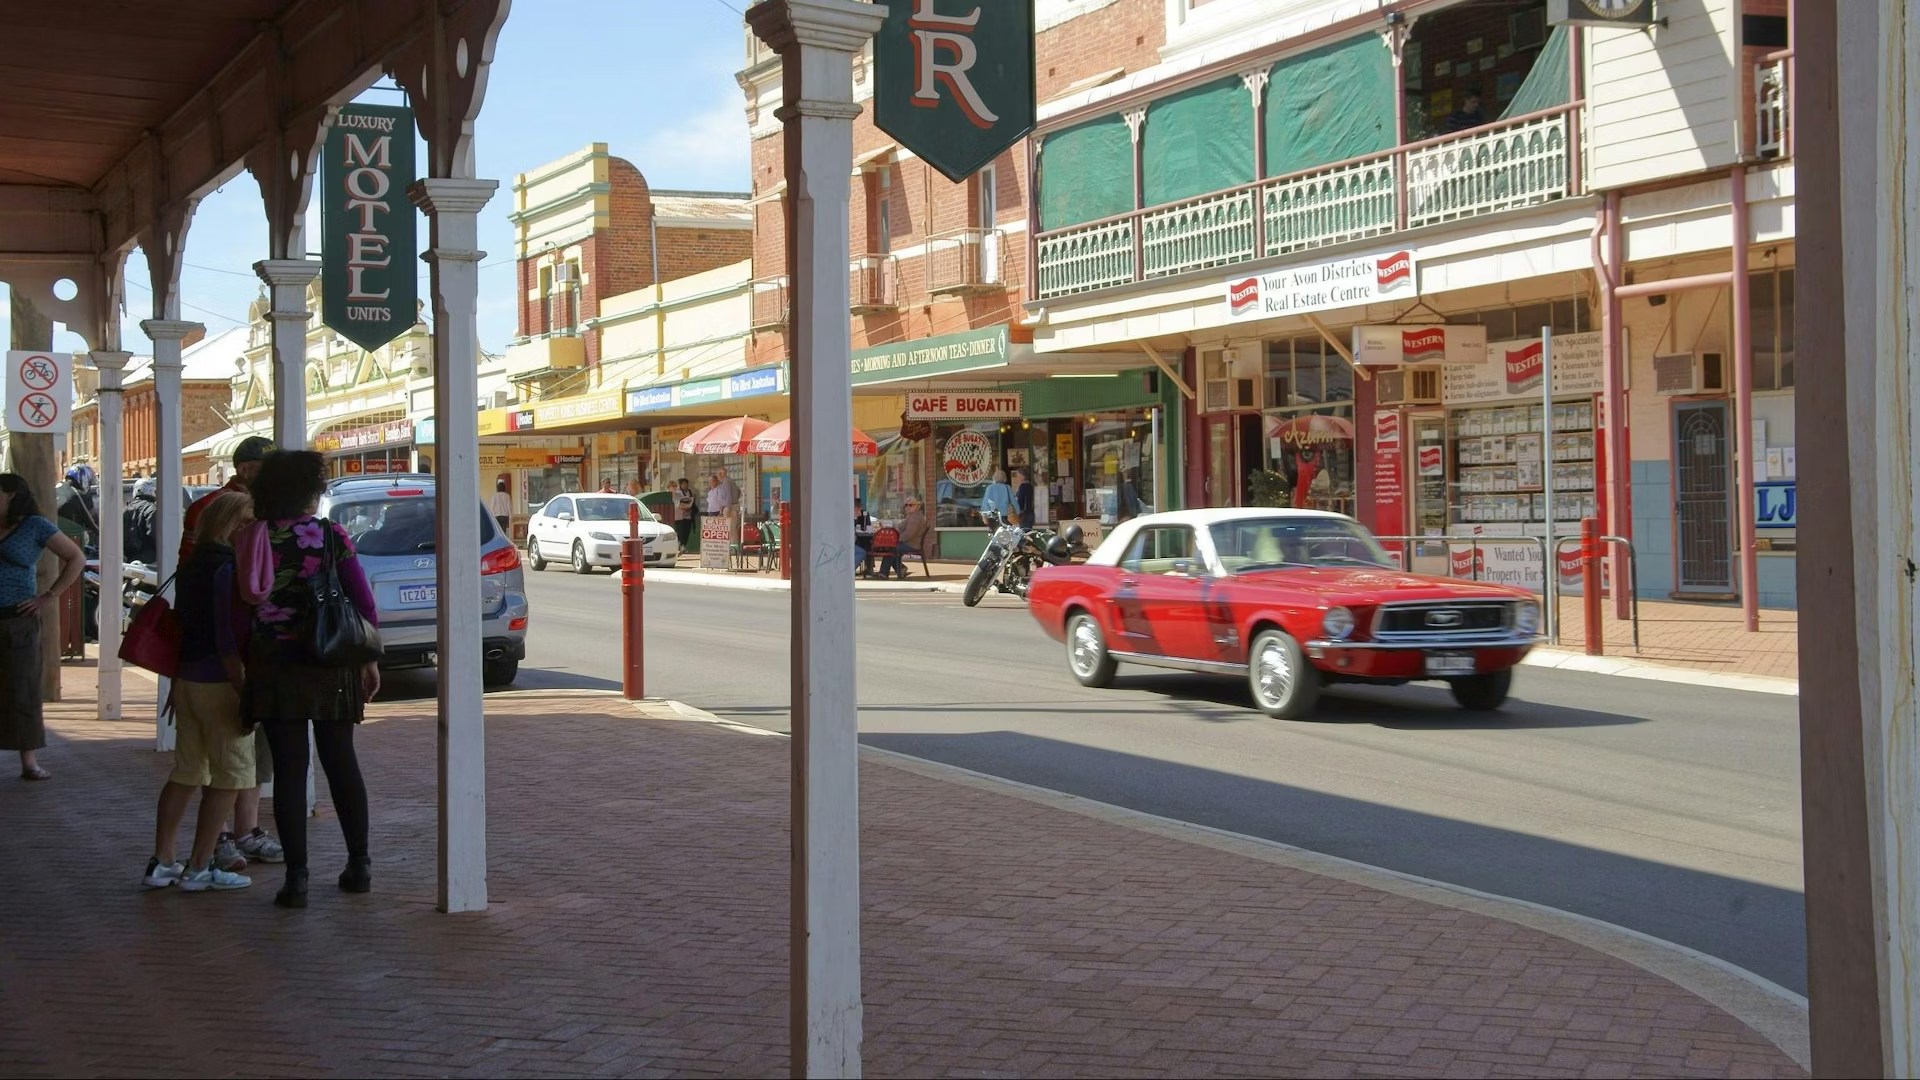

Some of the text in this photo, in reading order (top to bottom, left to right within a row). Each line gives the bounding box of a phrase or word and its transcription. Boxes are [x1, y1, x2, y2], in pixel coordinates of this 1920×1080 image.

[338, 113, 397, 133] LUXURY
[343, 132, 393, 303] MOTEL
[1262, 258, 1373, 292] Your Avon Districts
[1378, 259, 1410, 278] WESTERN
[1230, 285, 1258, 302] WESTERN
[1265, 284, 1371, 313] Real Estate Centre
[346, 305, 392, 322] UNITS
[1403, 335, 1444, 349] WESTERN
[863, 355, 891, 372] MORNING
[892, 352, 907, 368] AND
[908, 346, 948, 366] AFTERNOON
[949, 342, 967, 360] TEAS
[969, 337, 996, 356] DINNER
[1507, 356, 1543, 374] WESTER
[956, 398, 1017, 412] BUGATTI
[479, 456, 493, 464] ORK
[703, 531, 729, 539] OPEN
[1494, 546, 1543, 562] Wanted You
[1486, 566, 1522, 585] Property
[1524, 566, 1539, 581] For
